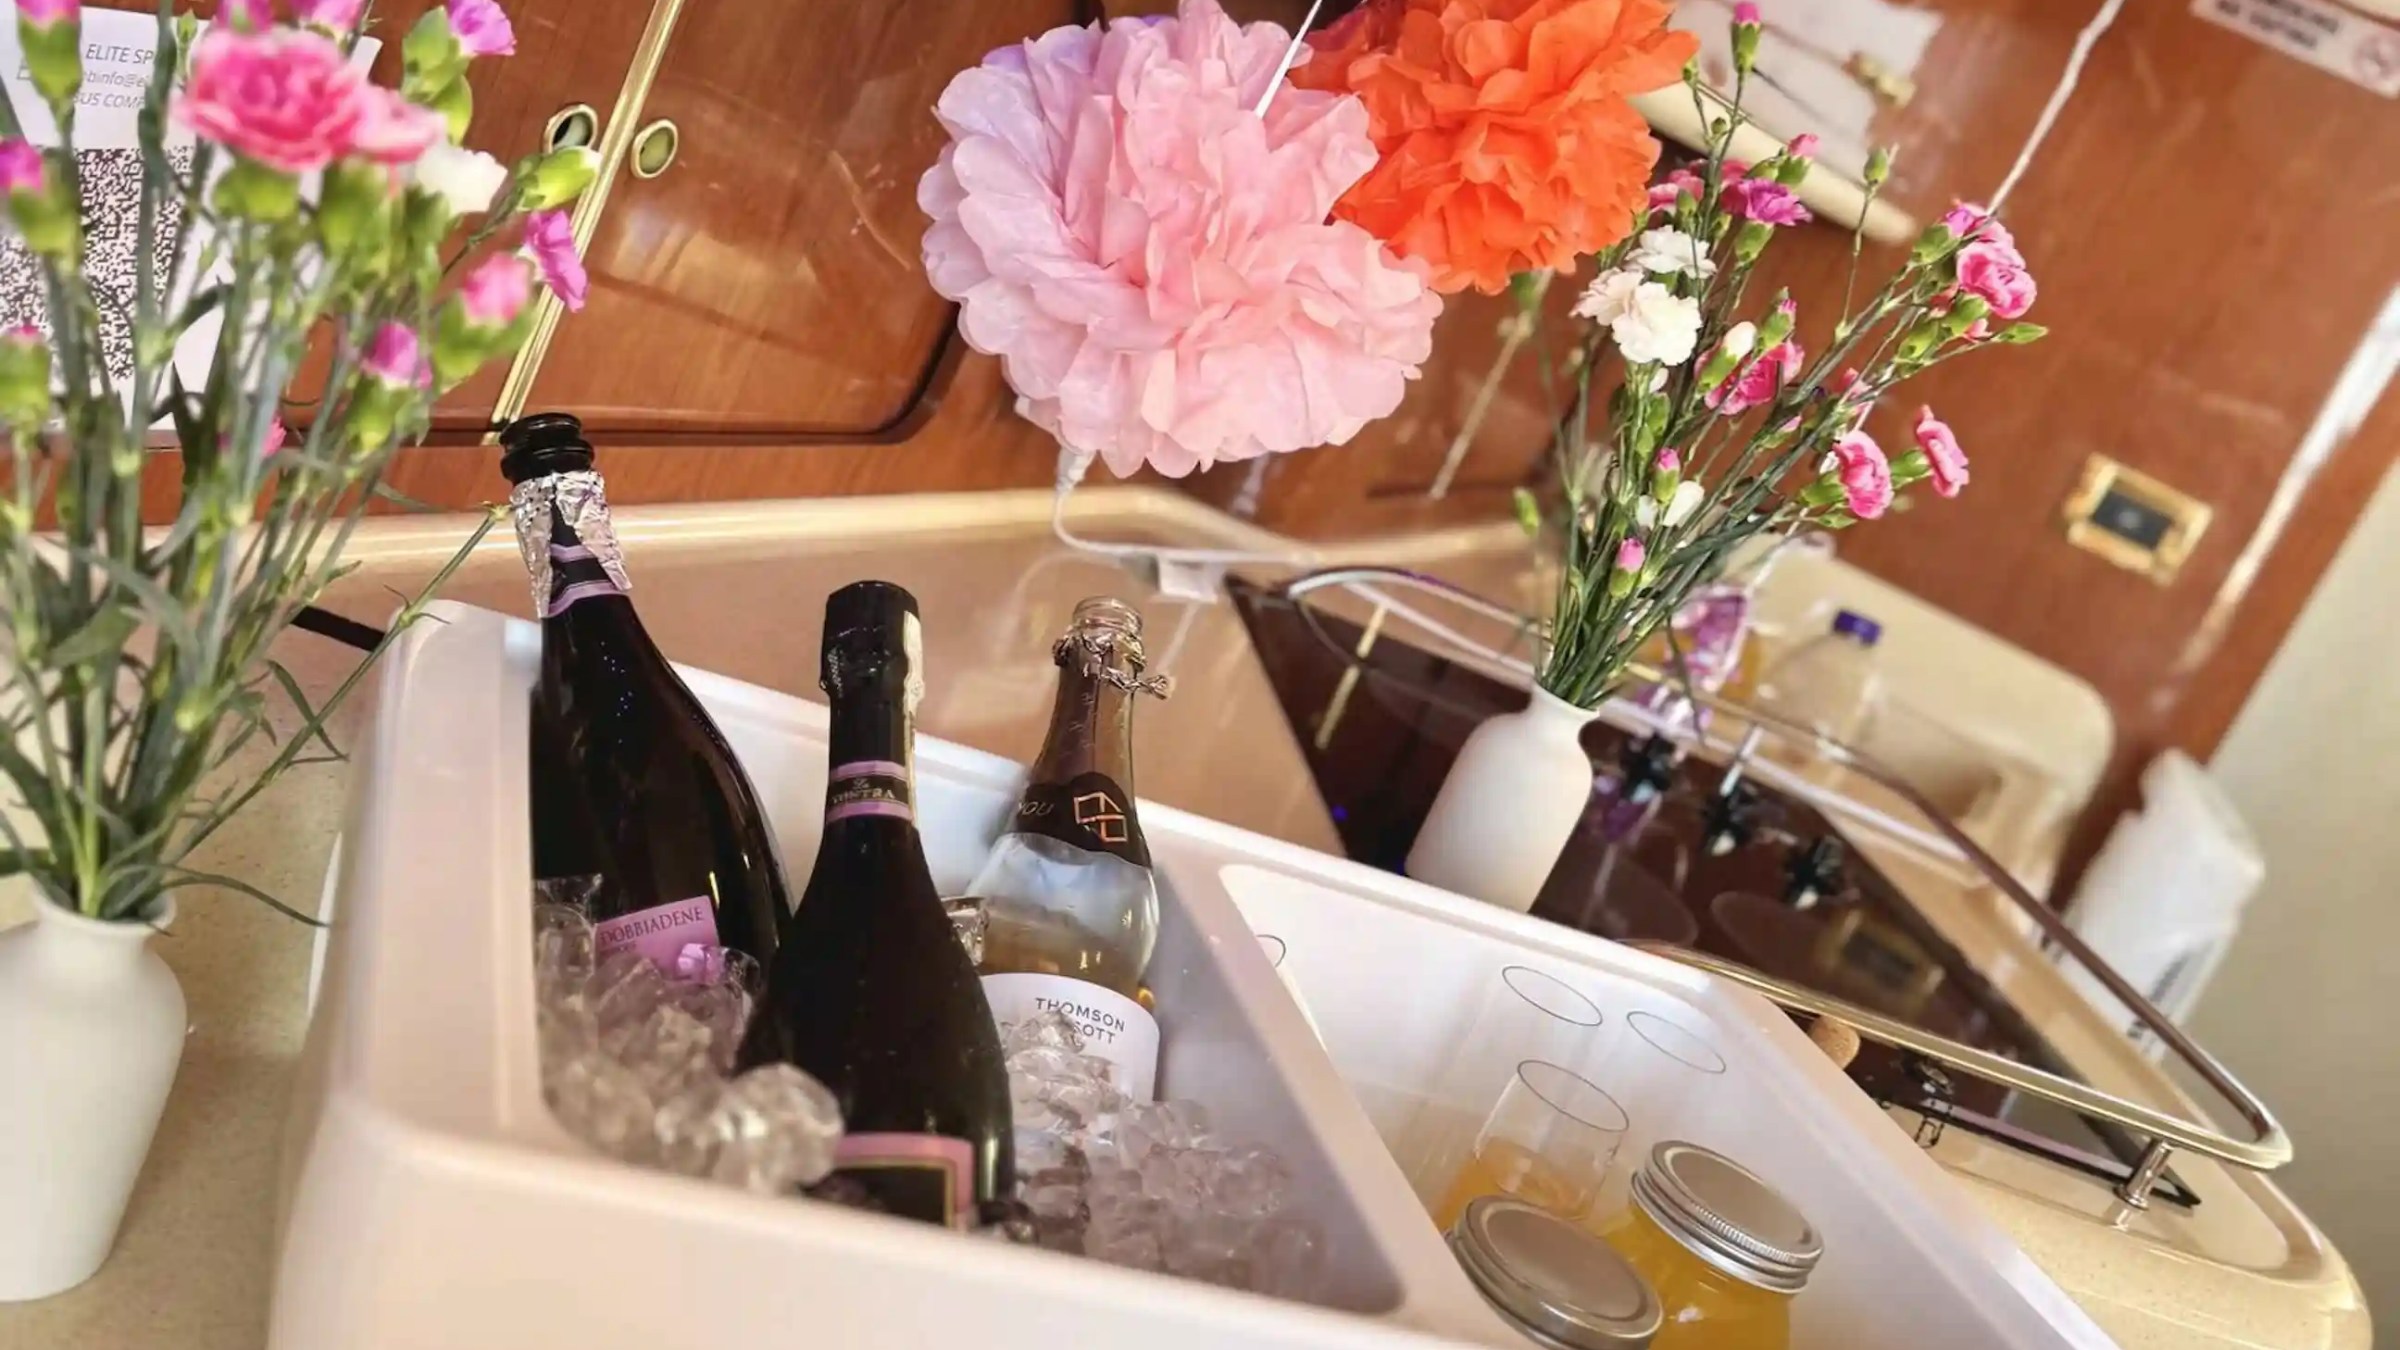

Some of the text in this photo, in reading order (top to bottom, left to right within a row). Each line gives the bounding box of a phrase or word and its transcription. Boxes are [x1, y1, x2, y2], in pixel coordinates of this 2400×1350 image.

[86, 43, 131, 63] ELITE
[600, 907, 704, 944] DOBBIADENE
[1035, 997, 1125, 1032] THOMSON
